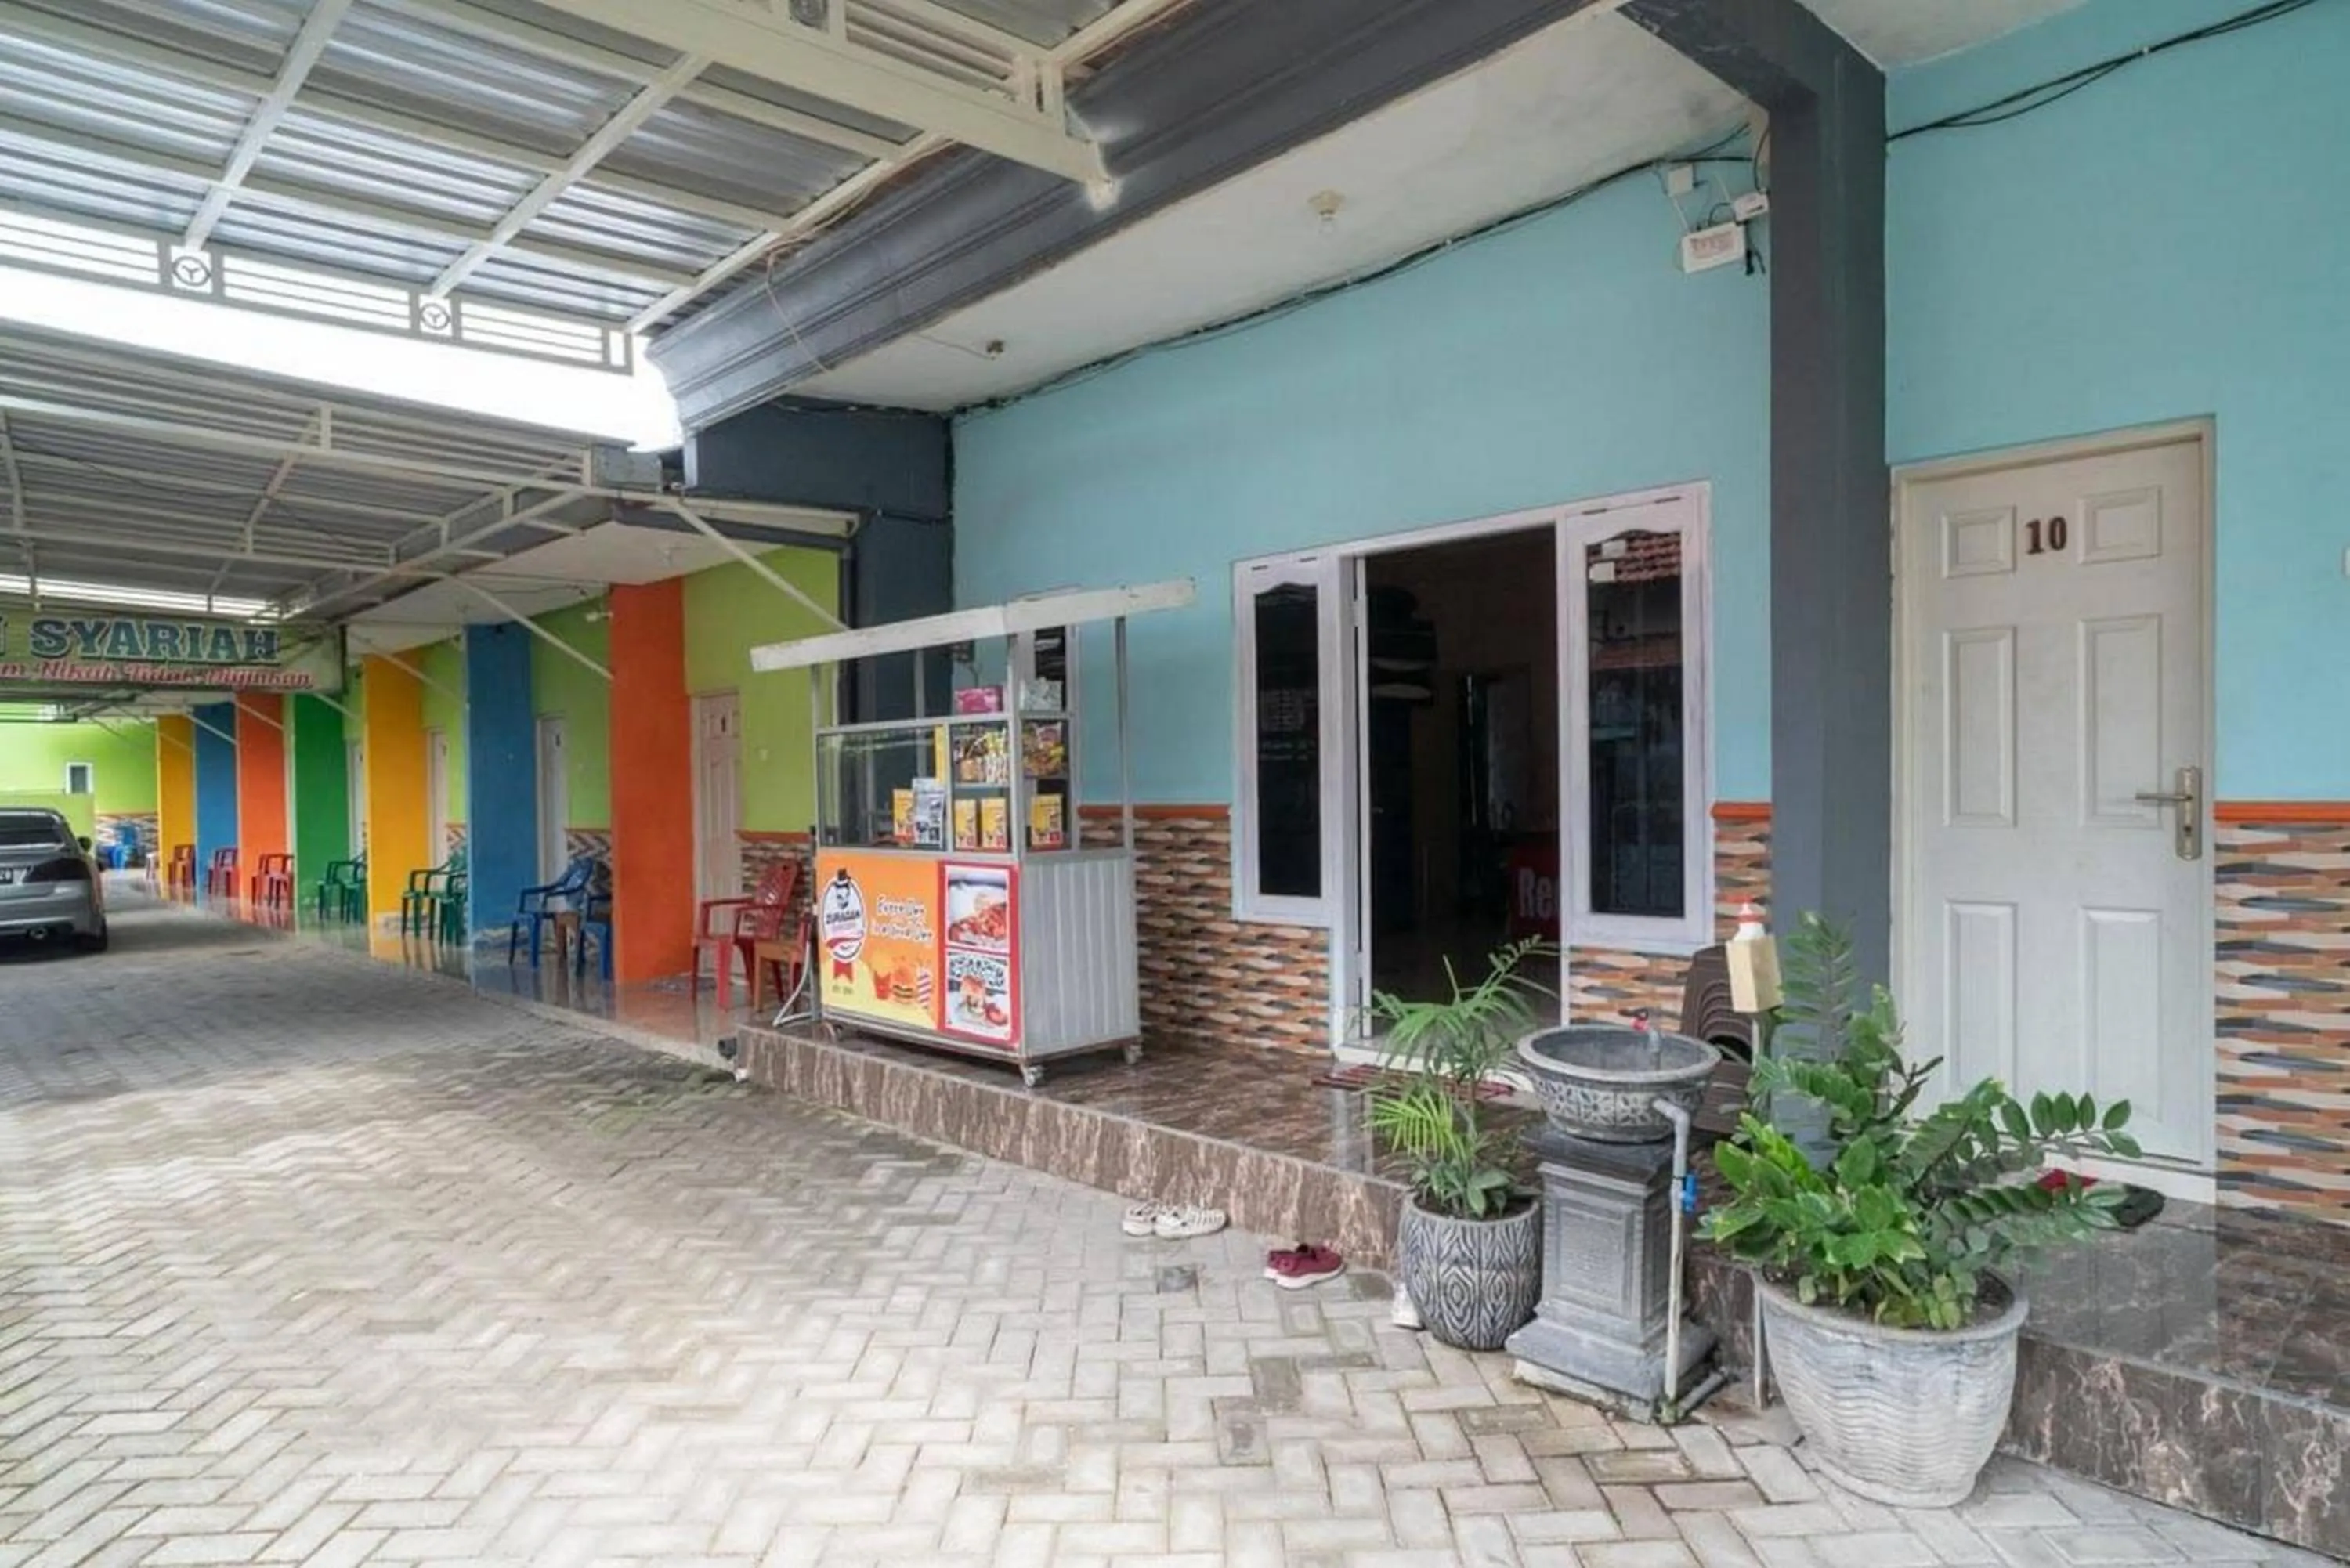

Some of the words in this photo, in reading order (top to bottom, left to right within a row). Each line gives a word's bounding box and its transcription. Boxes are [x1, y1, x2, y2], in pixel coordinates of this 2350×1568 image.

[2025, 516, 2067, 555] 10
[30, 617, 280, 664] SYARIAH
[1519, 866, 1560, 920] Re
